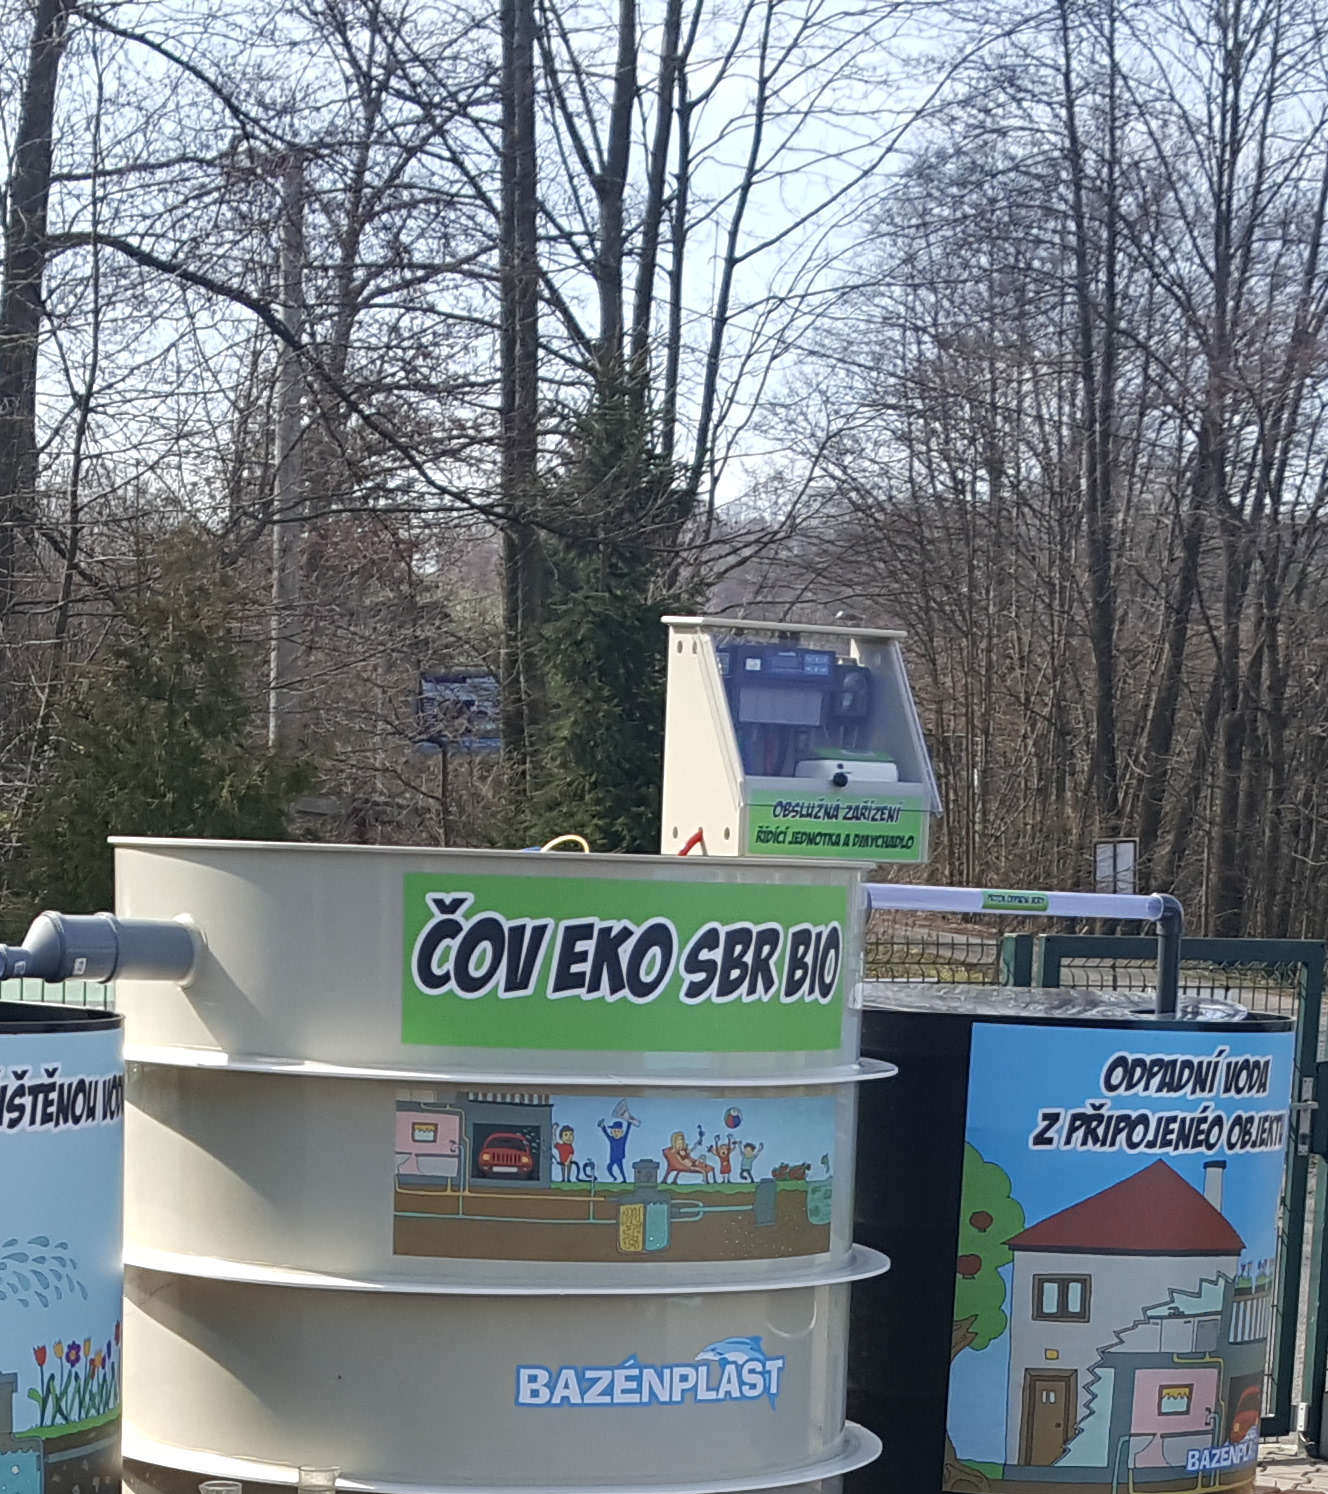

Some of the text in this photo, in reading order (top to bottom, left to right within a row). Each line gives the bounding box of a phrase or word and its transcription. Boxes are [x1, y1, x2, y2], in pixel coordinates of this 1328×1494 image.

[772, 797, 904, 823] OBSLUŽNÁ ZAŘÍZENÍ
[755, 825, 915, 850] ŘÍDÍCÍ JEDNOTKA A DMYCHADLO
[416, 896, 841, 999] ČOV EKO SBR BIO
[1103, 1048, 1271, 1096] ODPADNÍ VODA
[1032, 1112, 1061, 1147] Z
[1063, 1102, 1224, 1152] PŘIPOJENÉO
[516, 1354, 785, 1406] BAZÉNPLAST
